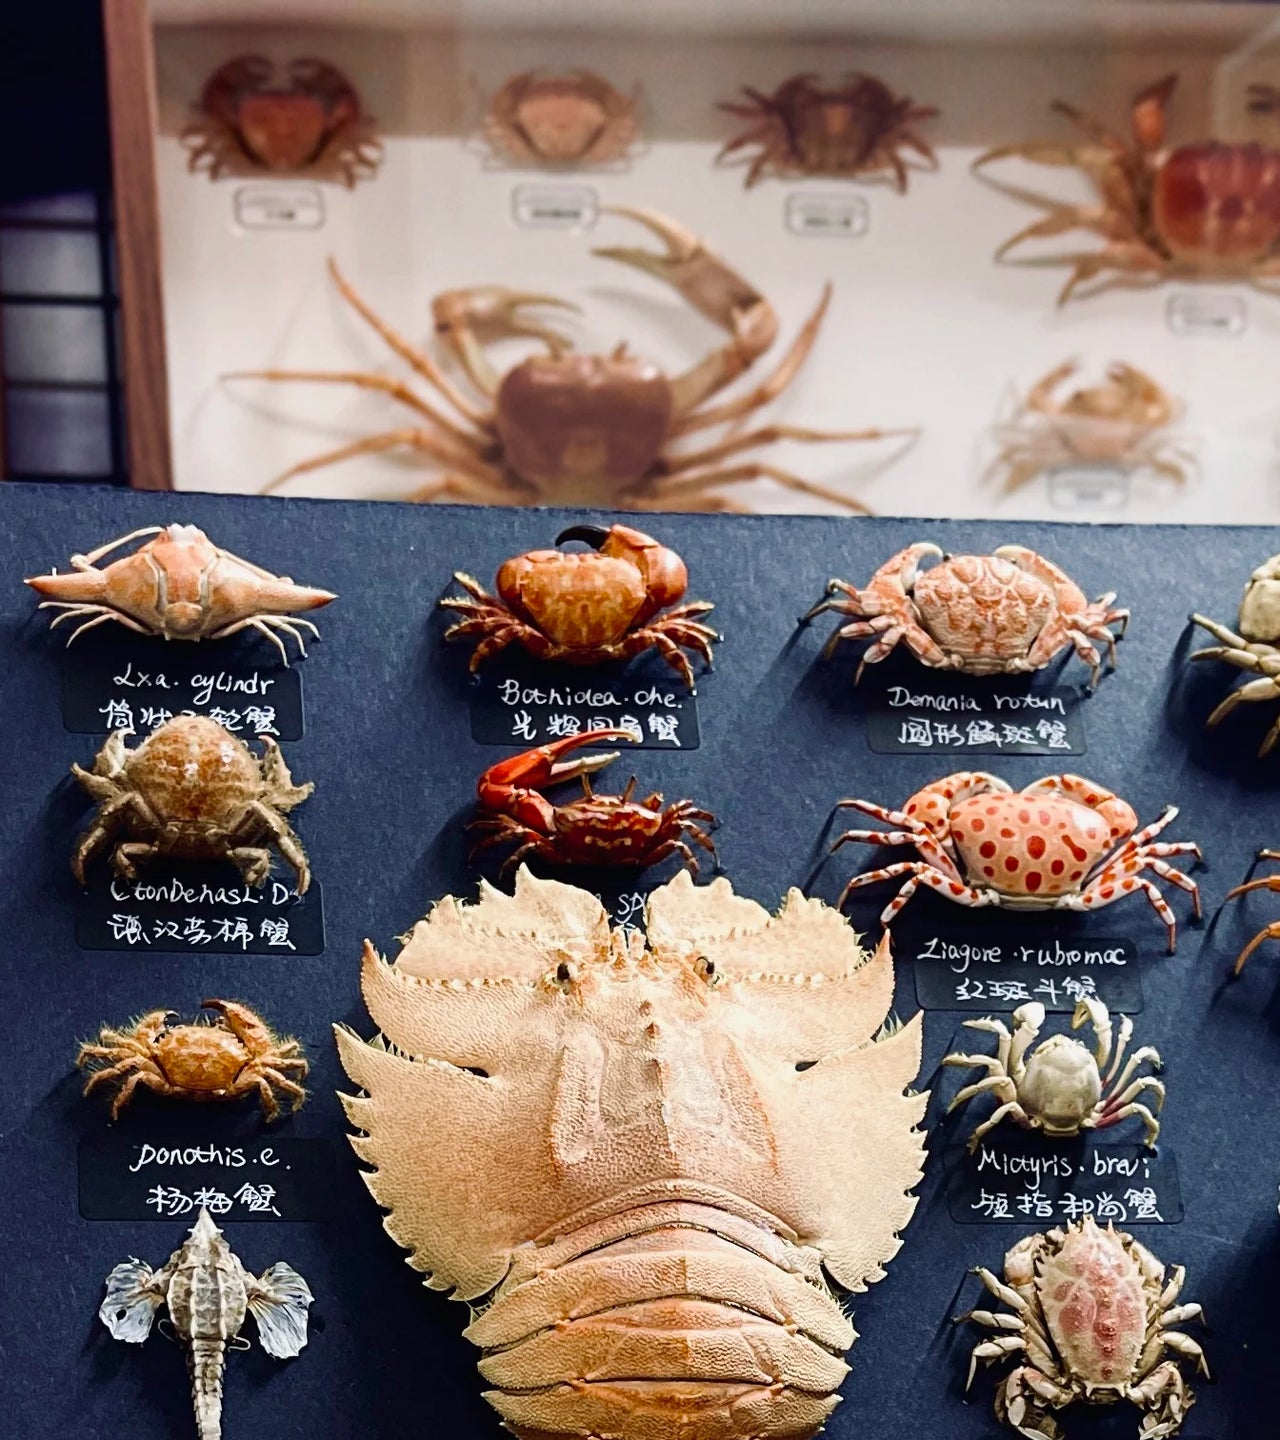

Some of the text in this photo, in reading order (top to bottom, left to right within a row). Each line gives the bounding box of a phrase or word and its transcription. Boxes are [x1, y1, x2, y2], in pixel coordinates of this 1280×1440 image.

[99, 699, 280, 736] 筒状轮蟹
[146, 1182, 281, 1217] 杨梅蟹
[971, 1187, 1164, 1222] 短指和尚蟹
